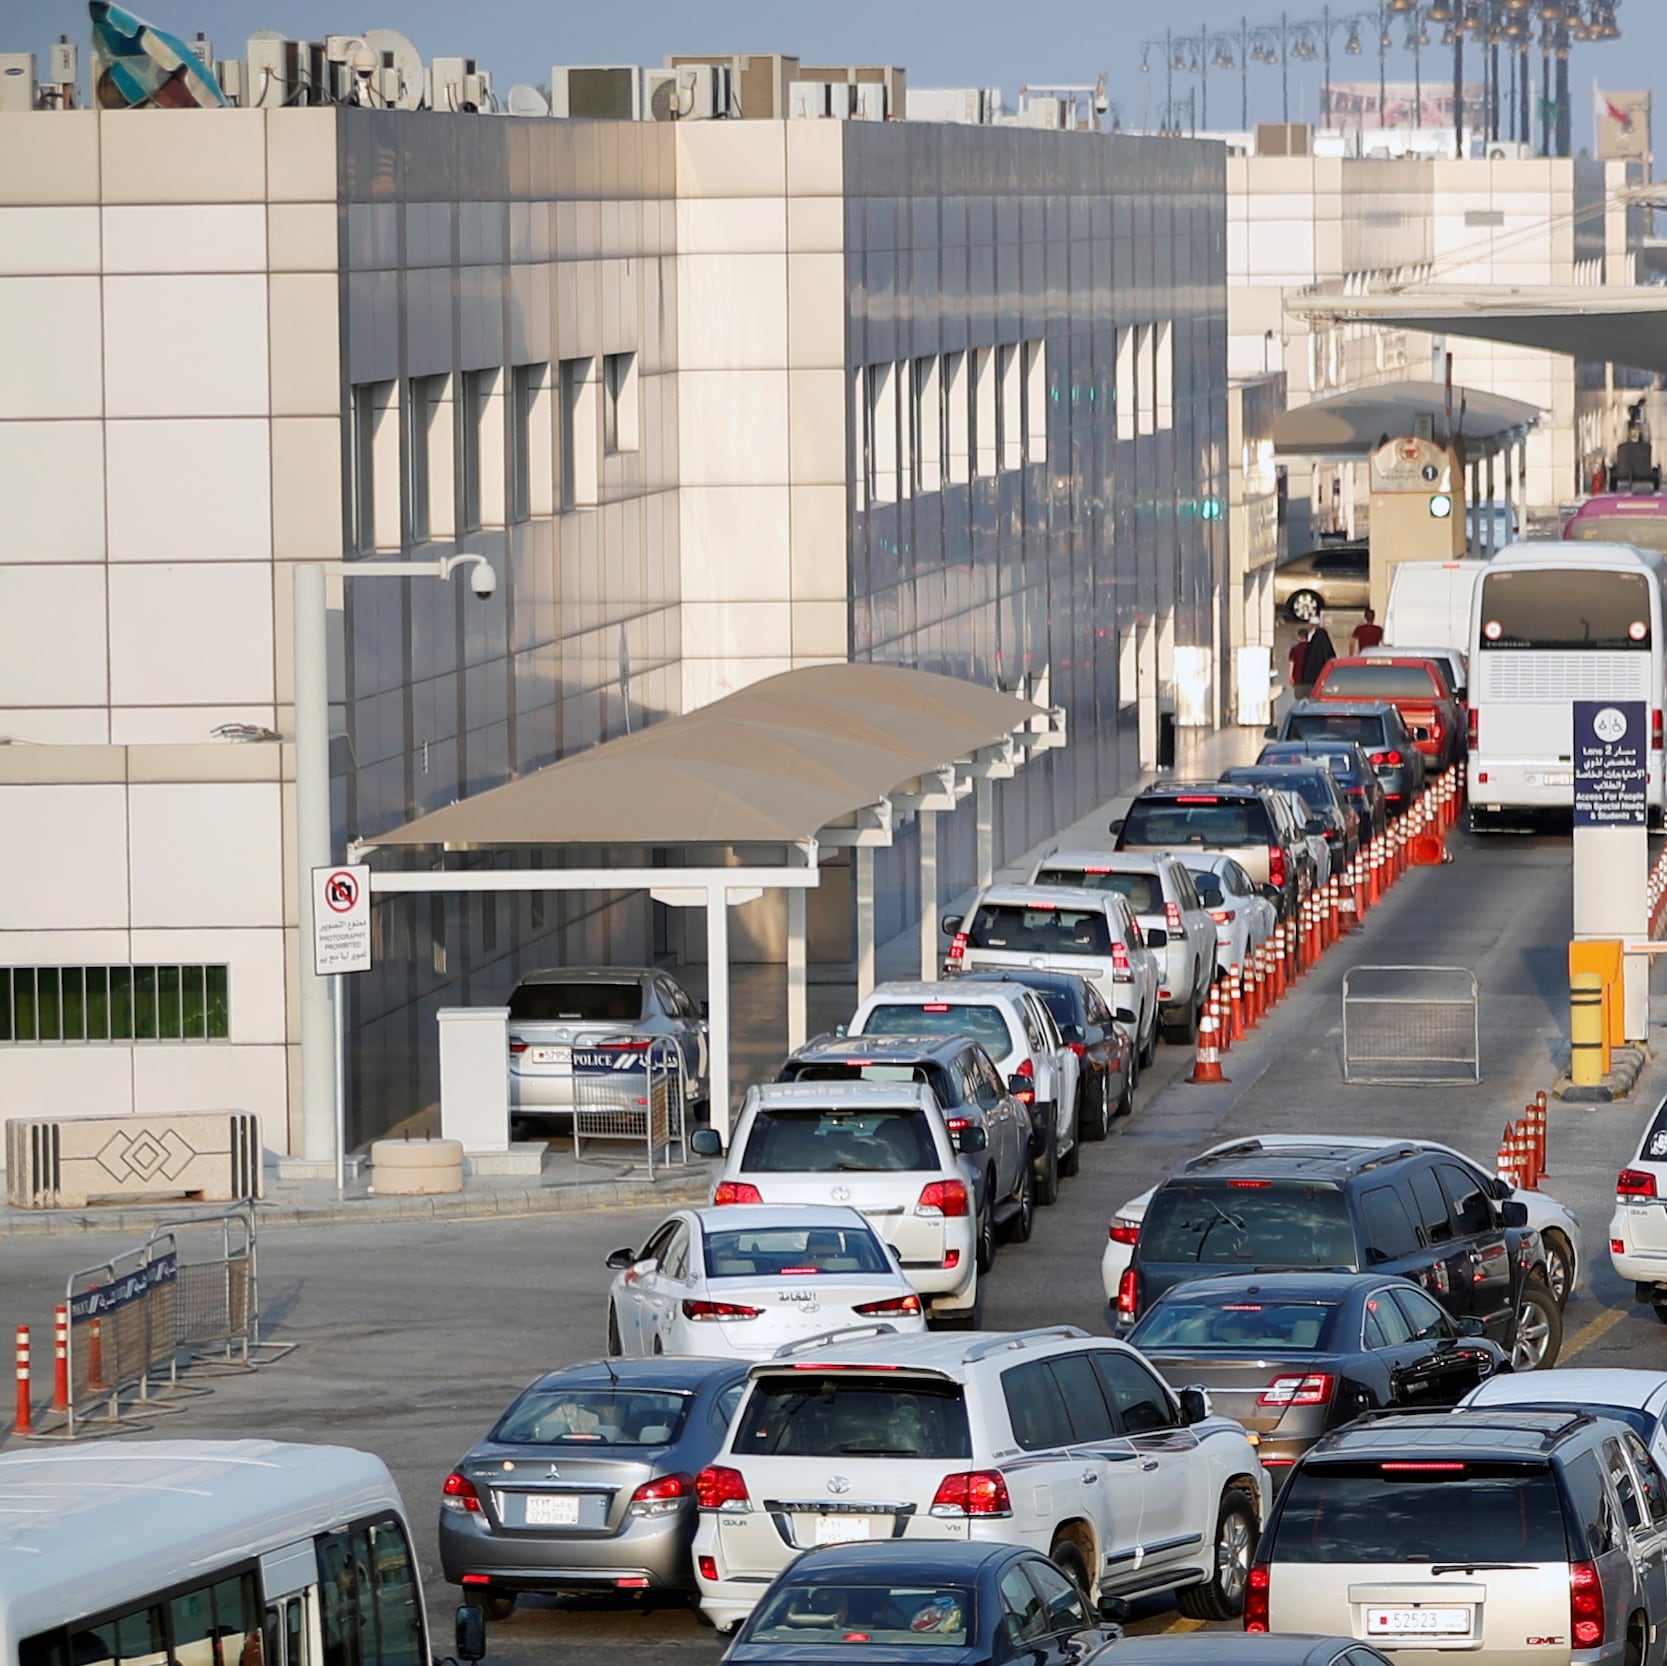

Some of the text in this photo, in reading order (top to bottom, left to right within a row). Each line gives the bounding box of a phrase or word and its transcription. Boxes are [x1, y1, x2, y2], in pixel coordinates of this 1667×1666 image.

[1604, 744, 1613, 756] 2
[1603, 792, 1618, 801] For
[1618, 792, 1645, 802] People
[573, 1054, 614, 1068] POLICE
[1392, 1612, 1438, 1629] 52523
[1526, 1636, 1565, 1646] GMC
